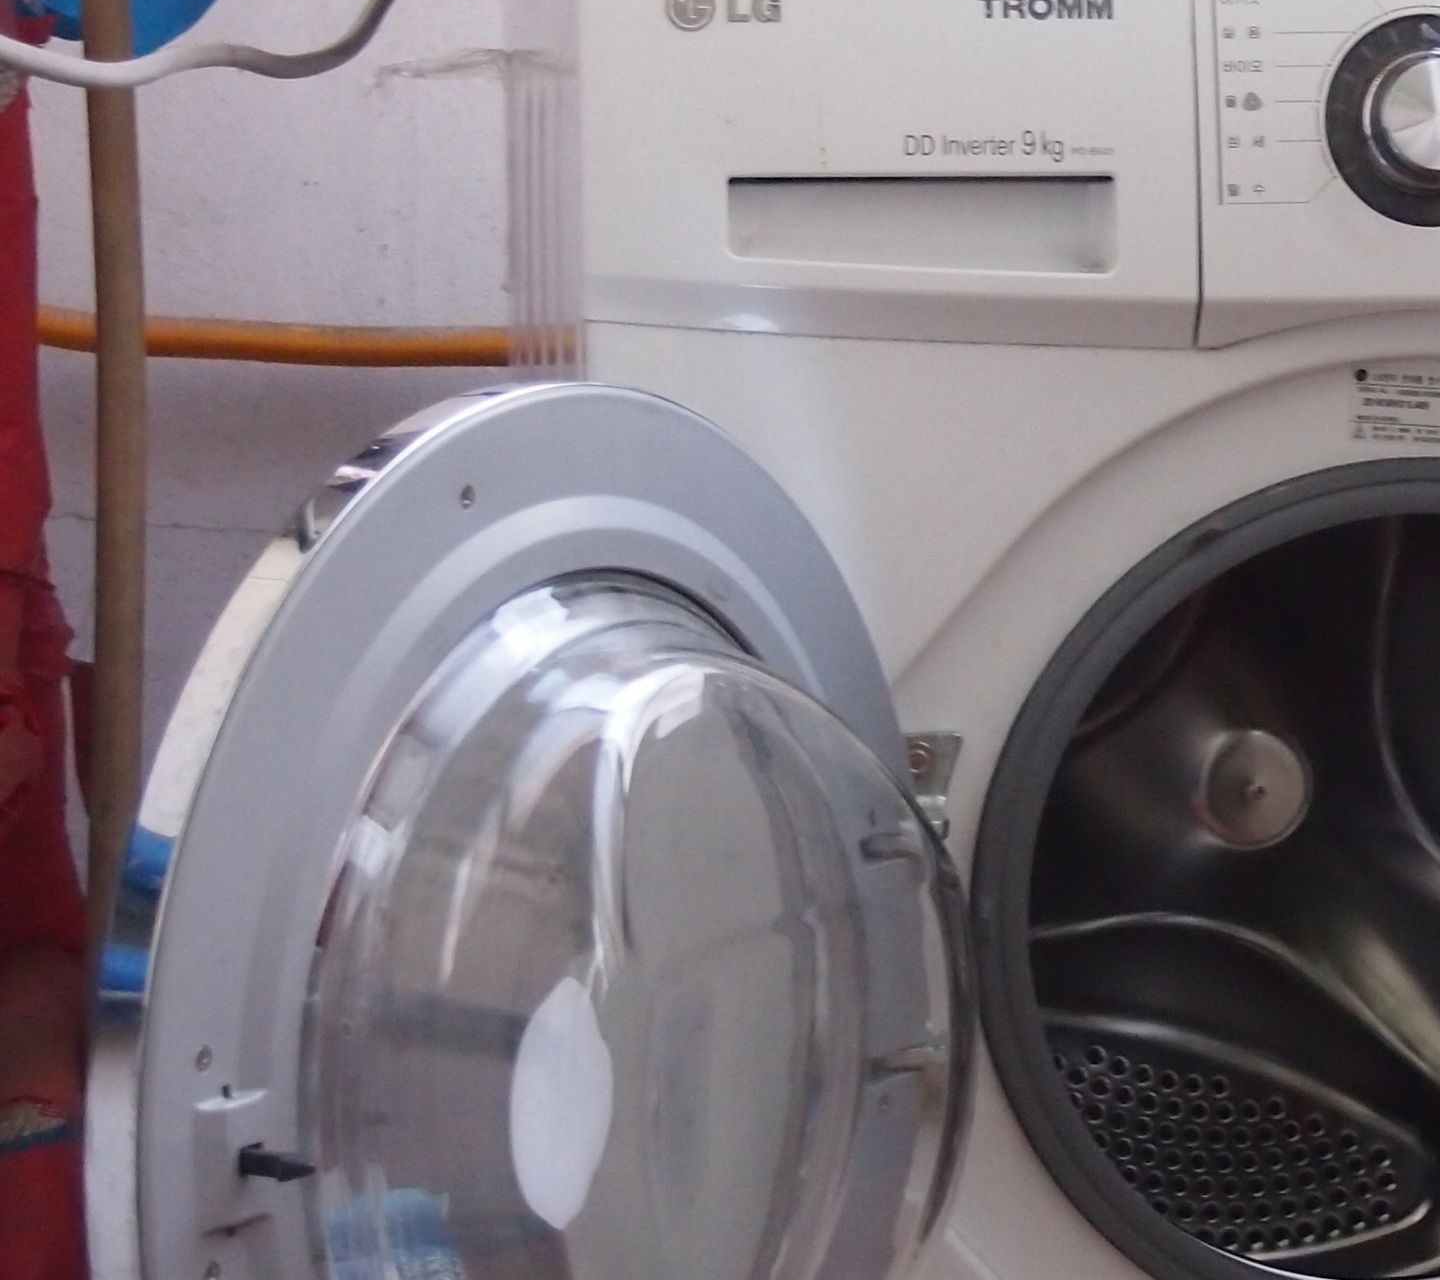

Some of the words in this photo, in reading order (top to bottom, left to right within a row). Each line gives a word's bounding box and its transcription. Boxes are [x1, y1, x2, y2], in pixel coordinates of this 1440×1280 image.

[903, 134, 935, 157] DD
[943, 134, 1016, 157] Inverter
[1021, 129, 1036, 156] 9
[1041, 130, 1065, 163] kg
